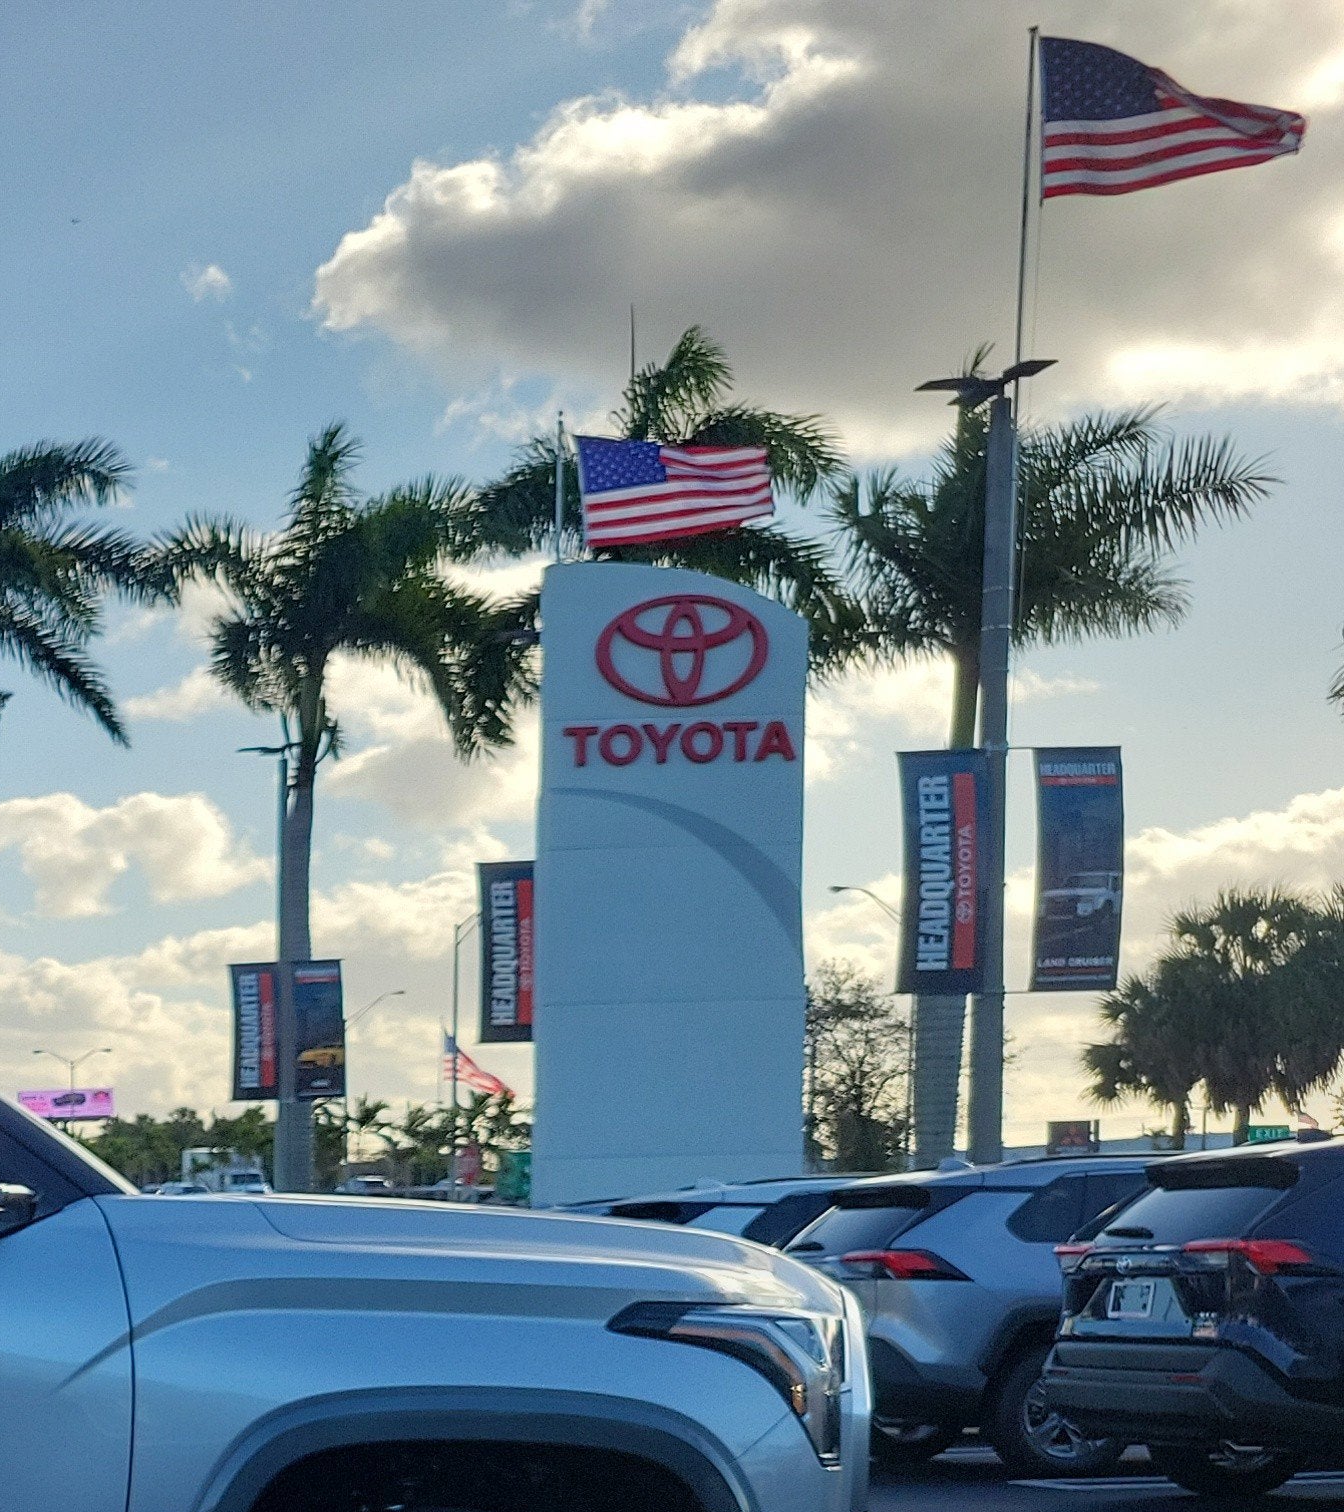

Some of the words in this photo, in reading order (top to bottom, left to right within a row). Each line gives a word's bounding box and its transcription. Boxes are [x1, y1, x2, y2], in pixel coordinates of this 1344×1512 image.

[563, 720, 797, 767] TOYOTA
[917, 774, 952, 971] HEADQUARTER
[955, 826, 973, 899] TOYOTA
[491, 881, 518, 1026] HEADQUARTER
